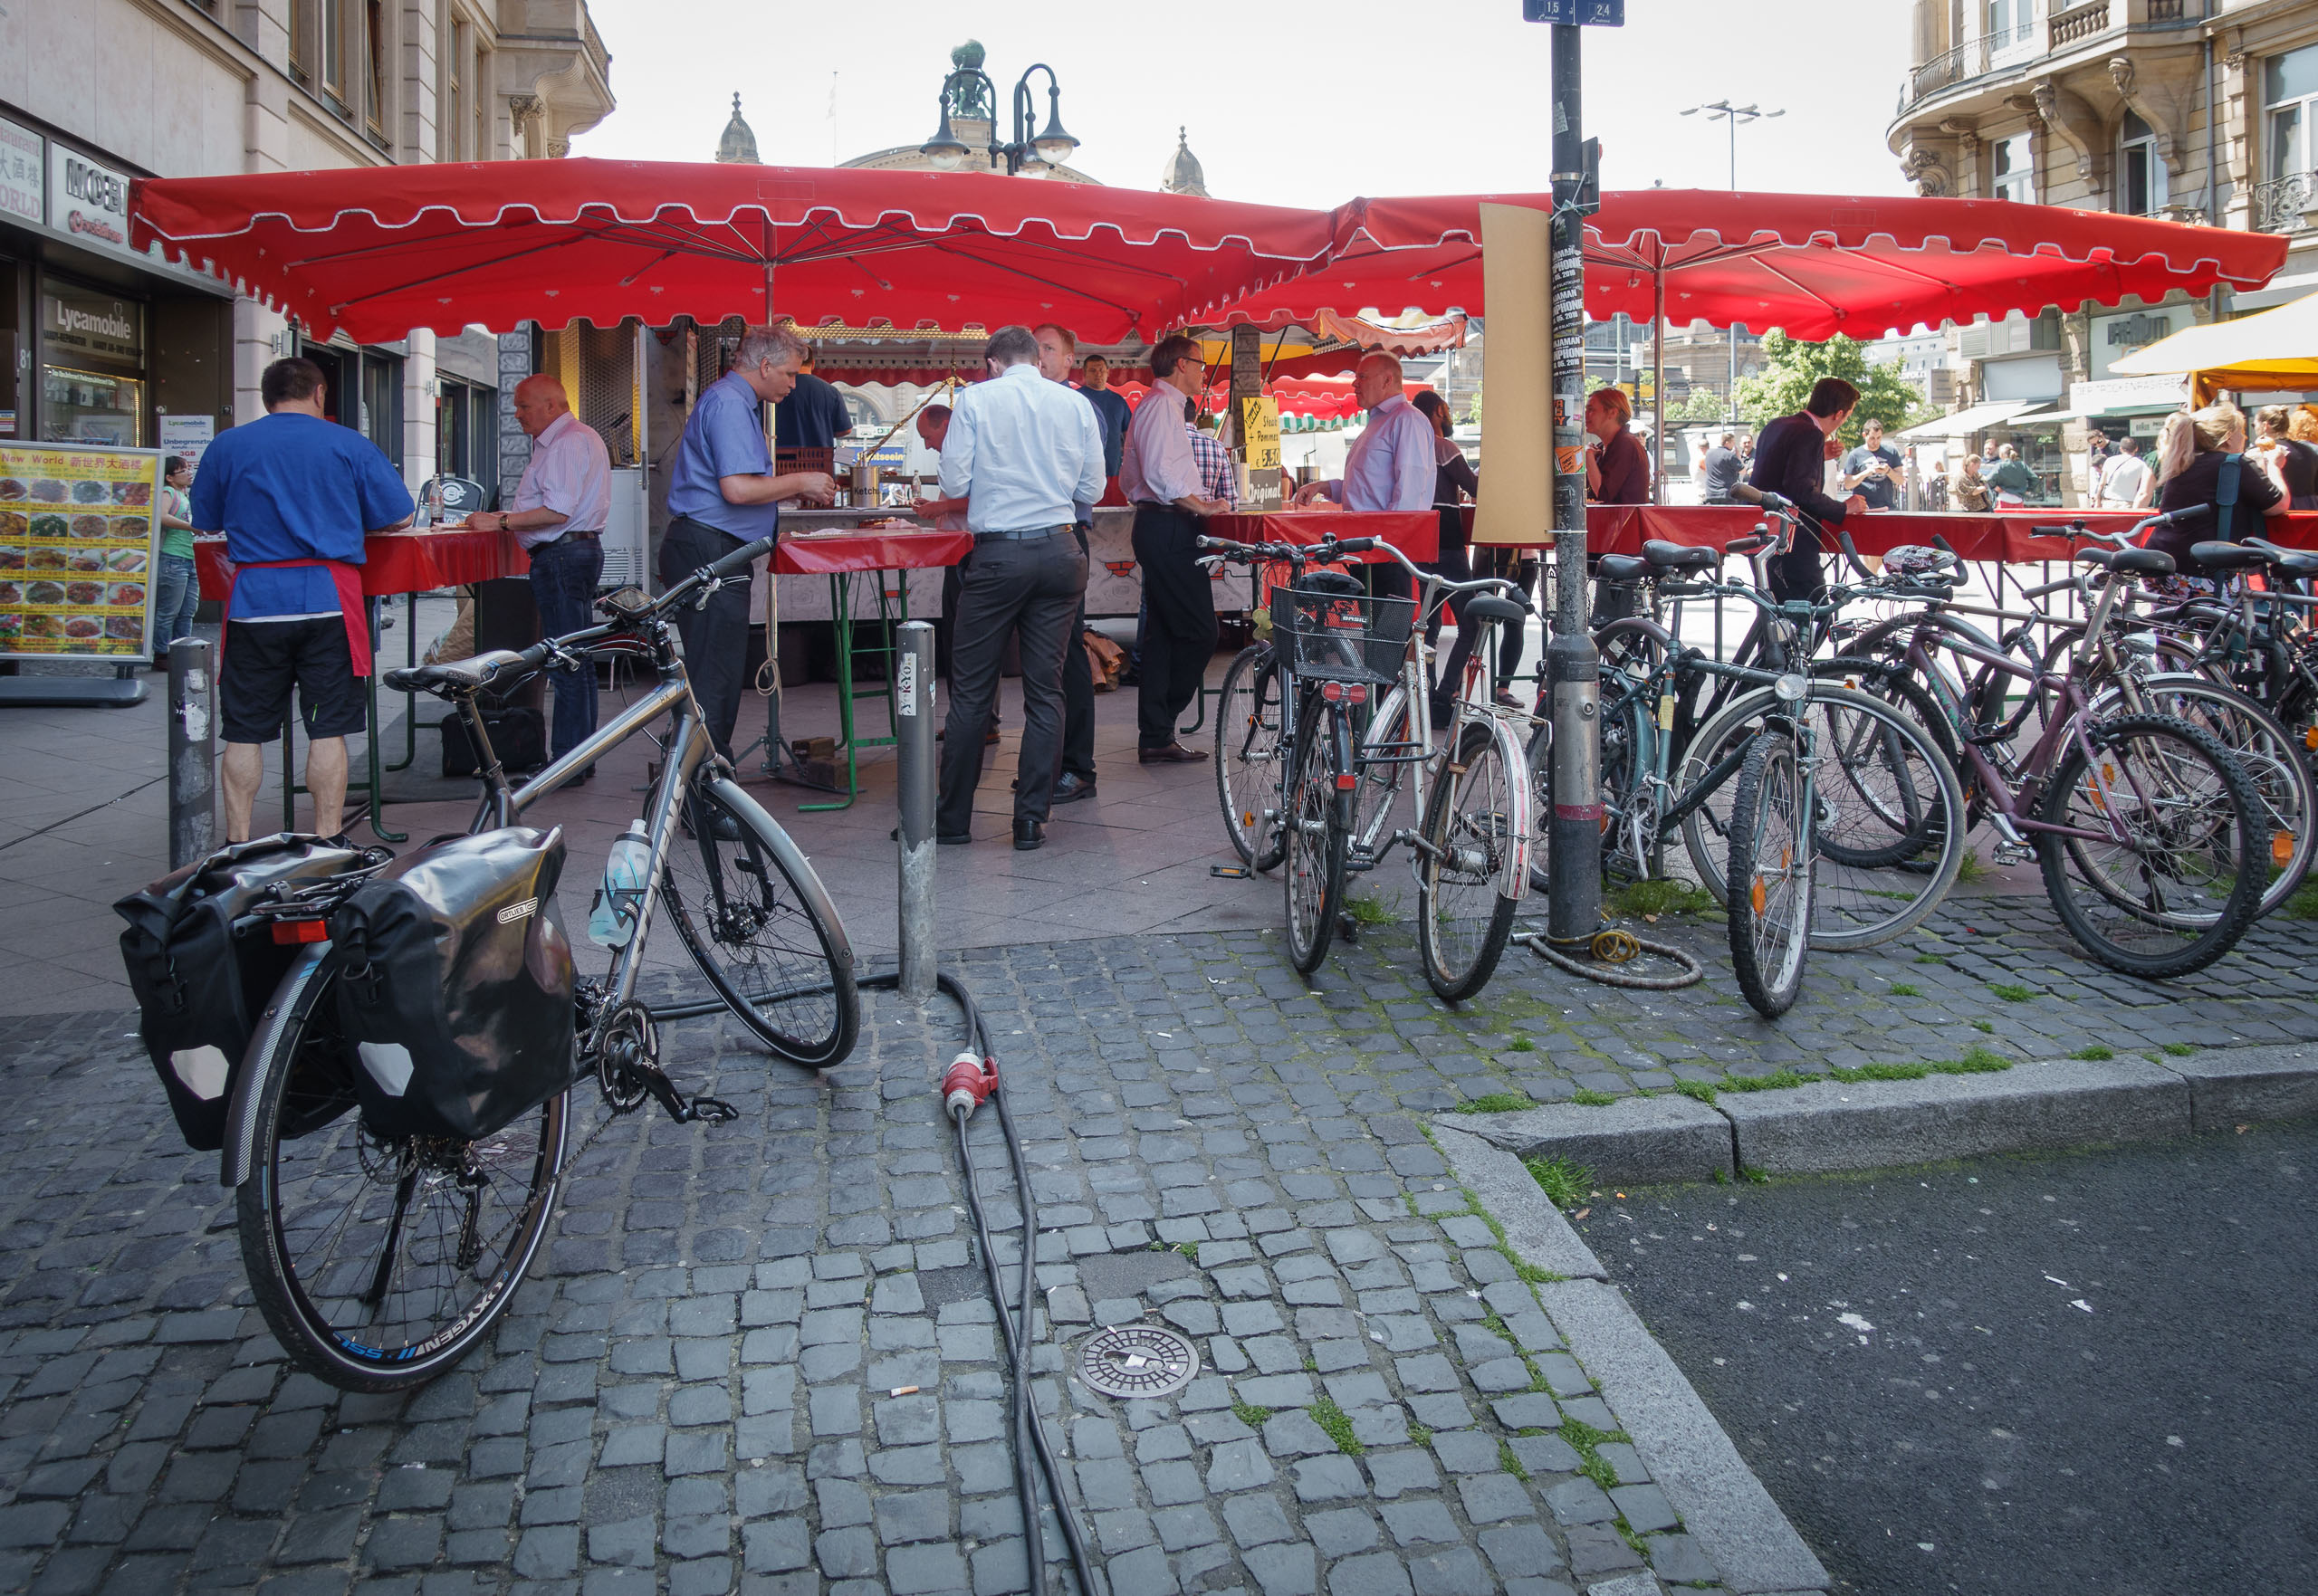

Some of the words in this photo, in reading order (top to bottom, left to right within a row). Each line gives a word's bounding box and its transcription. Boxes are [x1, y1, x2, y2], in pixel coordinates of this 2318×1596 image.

[1547, 2, 1559, 14] 1,5
[1596, 5, 1610, 17] 2,4
[57, 300, 131, 339] Lycamobile
[20, 349, 32, 370] 81
[1257, 430, 1279, 443] Pommes
[2, 454, 24, 464] New
[32, 454, 64, 464] World
[630, 773, 685, 969] STEVENS
[500, 906, 524, 921] ORTLIEB
